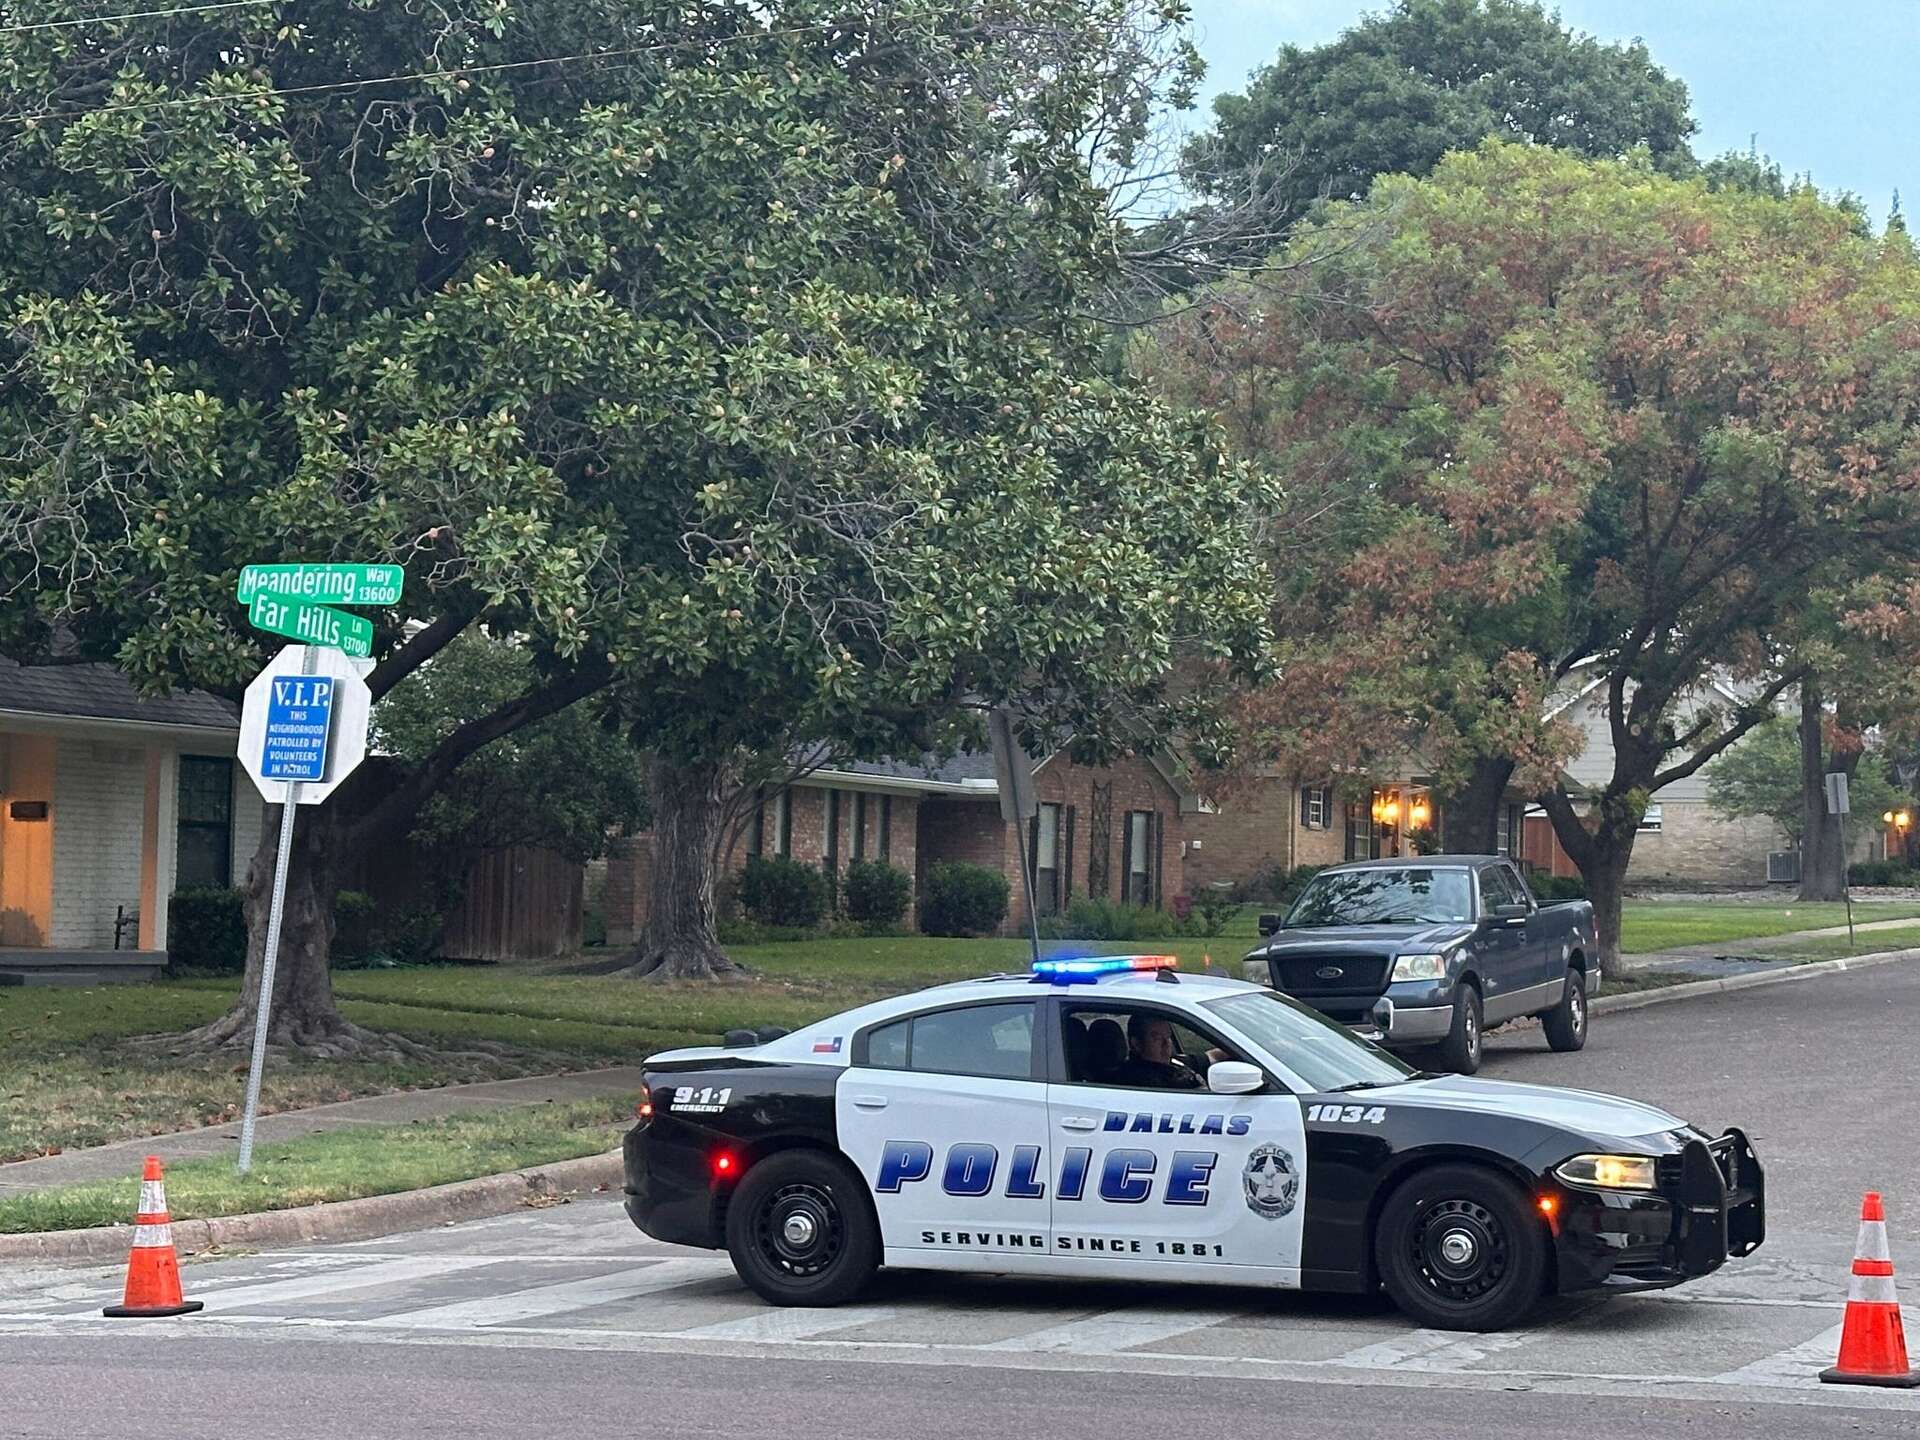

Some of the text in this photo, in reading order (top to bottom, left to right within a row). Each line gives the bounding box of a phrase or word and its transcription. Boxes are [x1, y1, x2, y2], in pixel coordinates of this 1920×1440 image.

[242, 566, 392, 602] Meandering Way
[359, 587, 395, 601] 13600
[254, 594, 362, 645] Far Hills Ln
[343, 636, 367, 655] 13700
[290, 711, 307, 721] THIS
[269, 724, 324, 735] NEIGHBORHOOD
[268, 737, 322, 748] PATROLLED BY
[270, 750, 317, 762] VOLUNTEERS
[271, 764, 311, 774] IN PATROL
[1307, 1104, 1386, 1124] 1034
[1102, 1112, 1252, 1136] DALLAS
[875, 1140, 1218, 1206] POLICE
[922, 1231, 1224, 1257] SERVING SINCE 1881
